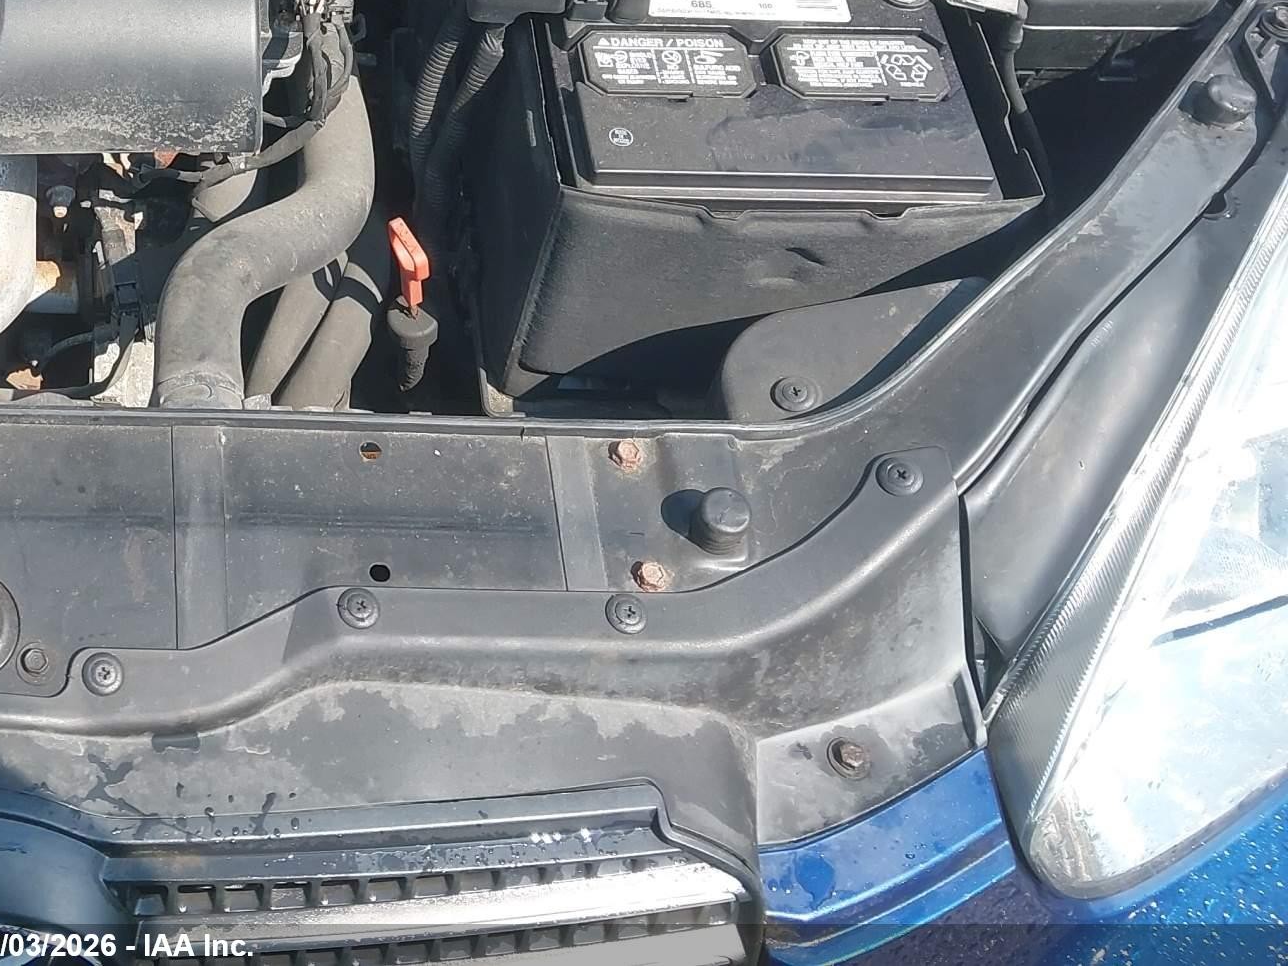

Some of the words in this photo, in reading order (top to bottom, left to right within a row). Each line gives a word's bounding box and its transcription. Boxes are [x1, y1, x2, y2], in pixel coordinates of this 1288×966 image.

[611, 38, 663, 47] DANGER
[665, 39, 674, 47] /
[676, 39, 724, 48] POISON
